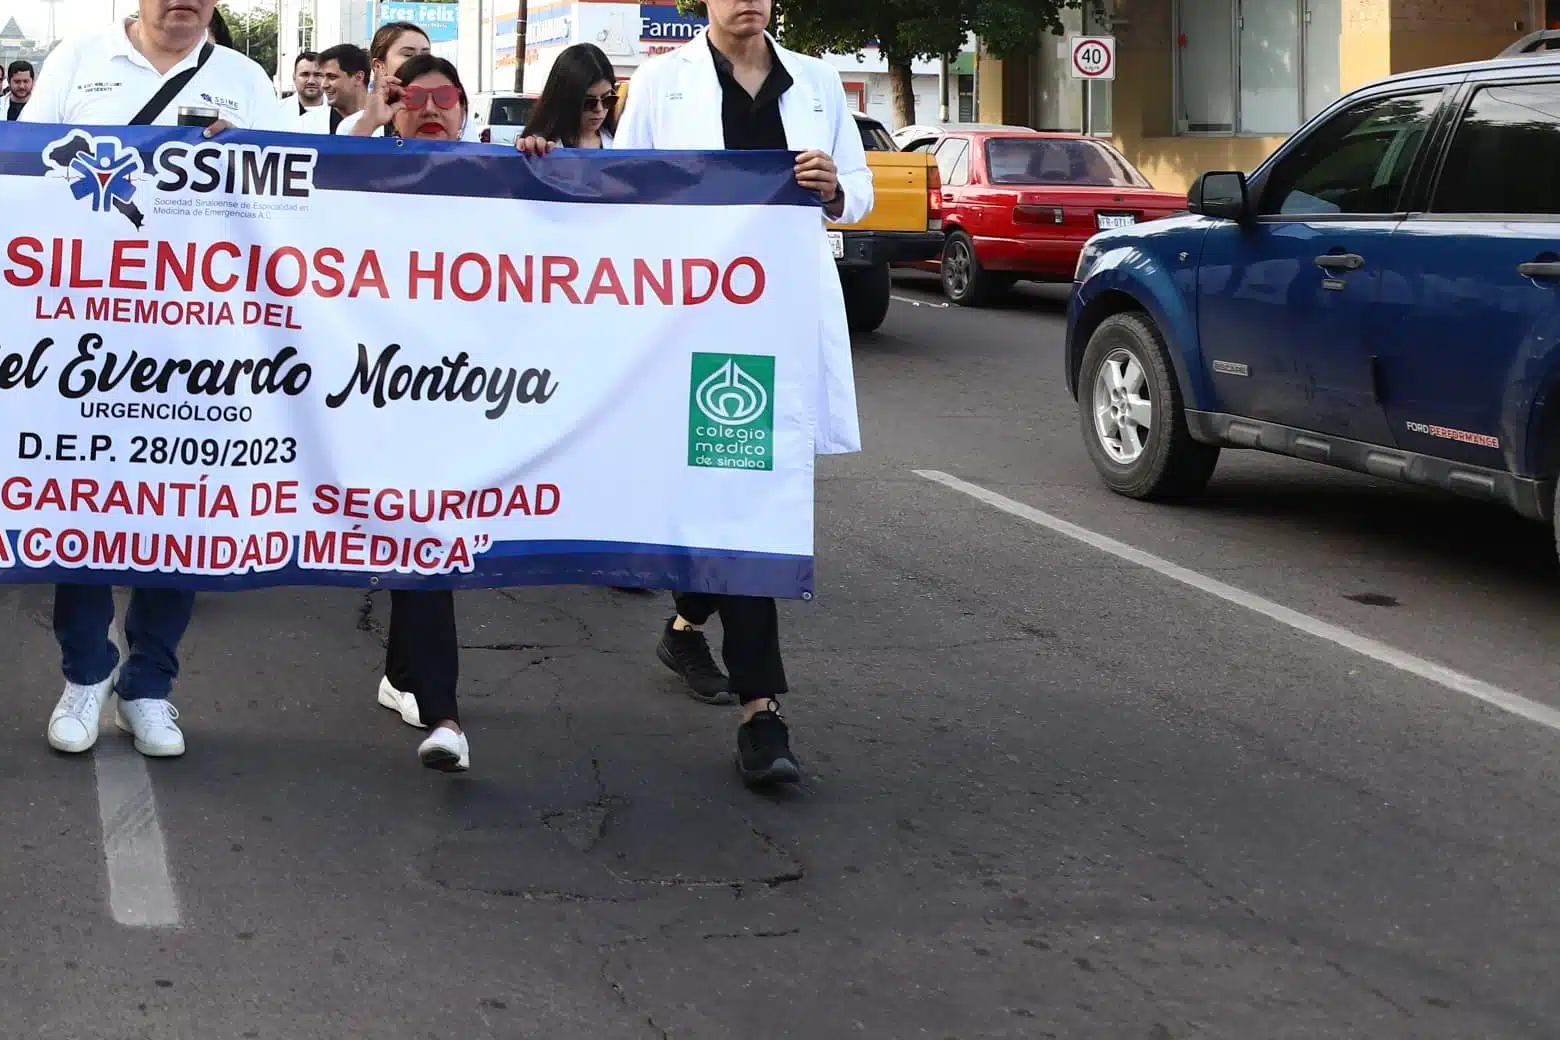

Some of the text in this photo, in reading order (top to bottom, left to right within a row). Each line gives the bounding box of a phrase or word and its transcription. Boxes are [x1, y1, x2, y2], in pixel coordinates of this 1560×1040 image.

[1081, 48, 1102, 65] 40
[156, 147, 313, 198] SSIME
[153, 206, 191, 216] Medicina
[192, 208, 203, 217] de
[204, 208, 257, 219] Emergencias
[154, 197, 193, 207] Sociedad
[195, 198, 239, 209] Sinaloense
[240, 200, 251, 209] de
[2, 236, 390, 299] SILENCIOSA
[407, 251, 767, 306] HONRANDO
[35, 296, 303, 329] LA MEMORIA DEL
[57, 331, 313, 398] Everardo
[324, 343, 560, 421] Montoya
[80, 398, 253, 423] URGENCIÓLOGO
[696, 424, 765, 443] colegio
[1406, 421, 1500, 448] FORD PERFORMANCE
[18, 431, 298, 467] D.E.P. 28/09/2023
[695, 442, 765, 456] medico
[695, 455, 766, 468] de sinaloa
[0, 476, 238, 516] GARANTÍA
[251, 480, 299, 516] DE
[312, 482, 561, 523] SEGURIDAD
[21, 529, 288, 570] COMUNIDAD
[303, 523, 490, 570] MÉDICA”
